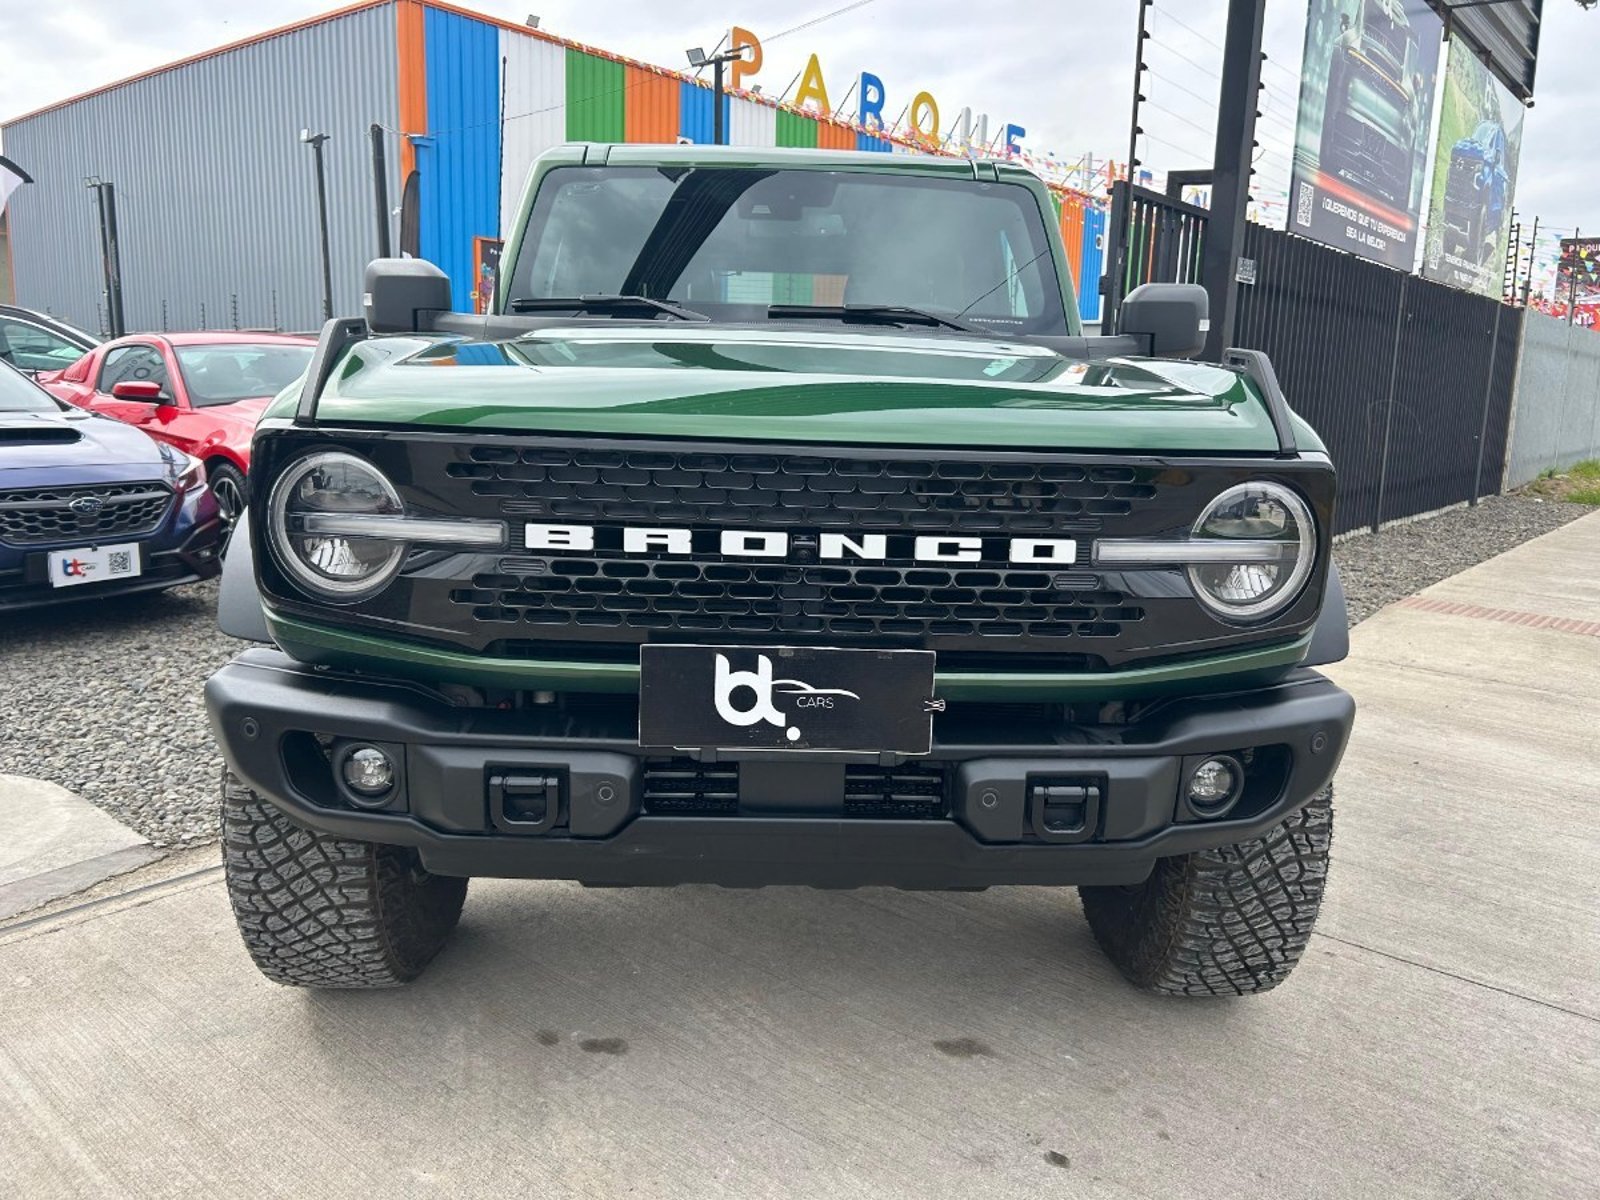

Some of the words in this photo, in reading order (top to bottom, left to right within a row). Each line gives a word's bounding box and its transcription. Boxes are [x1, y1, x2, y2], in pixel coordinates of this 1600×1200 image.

[728, 26, 1025, 158] PARQUE
[1358, 213, 1369, 228] QUE
[1346, 226, 1357, 240] SEA
[1358, 231, 1366, 244] LA
[524, 523, 1077, 564] BRONCO
[796, 696, 834, 709] CARS
